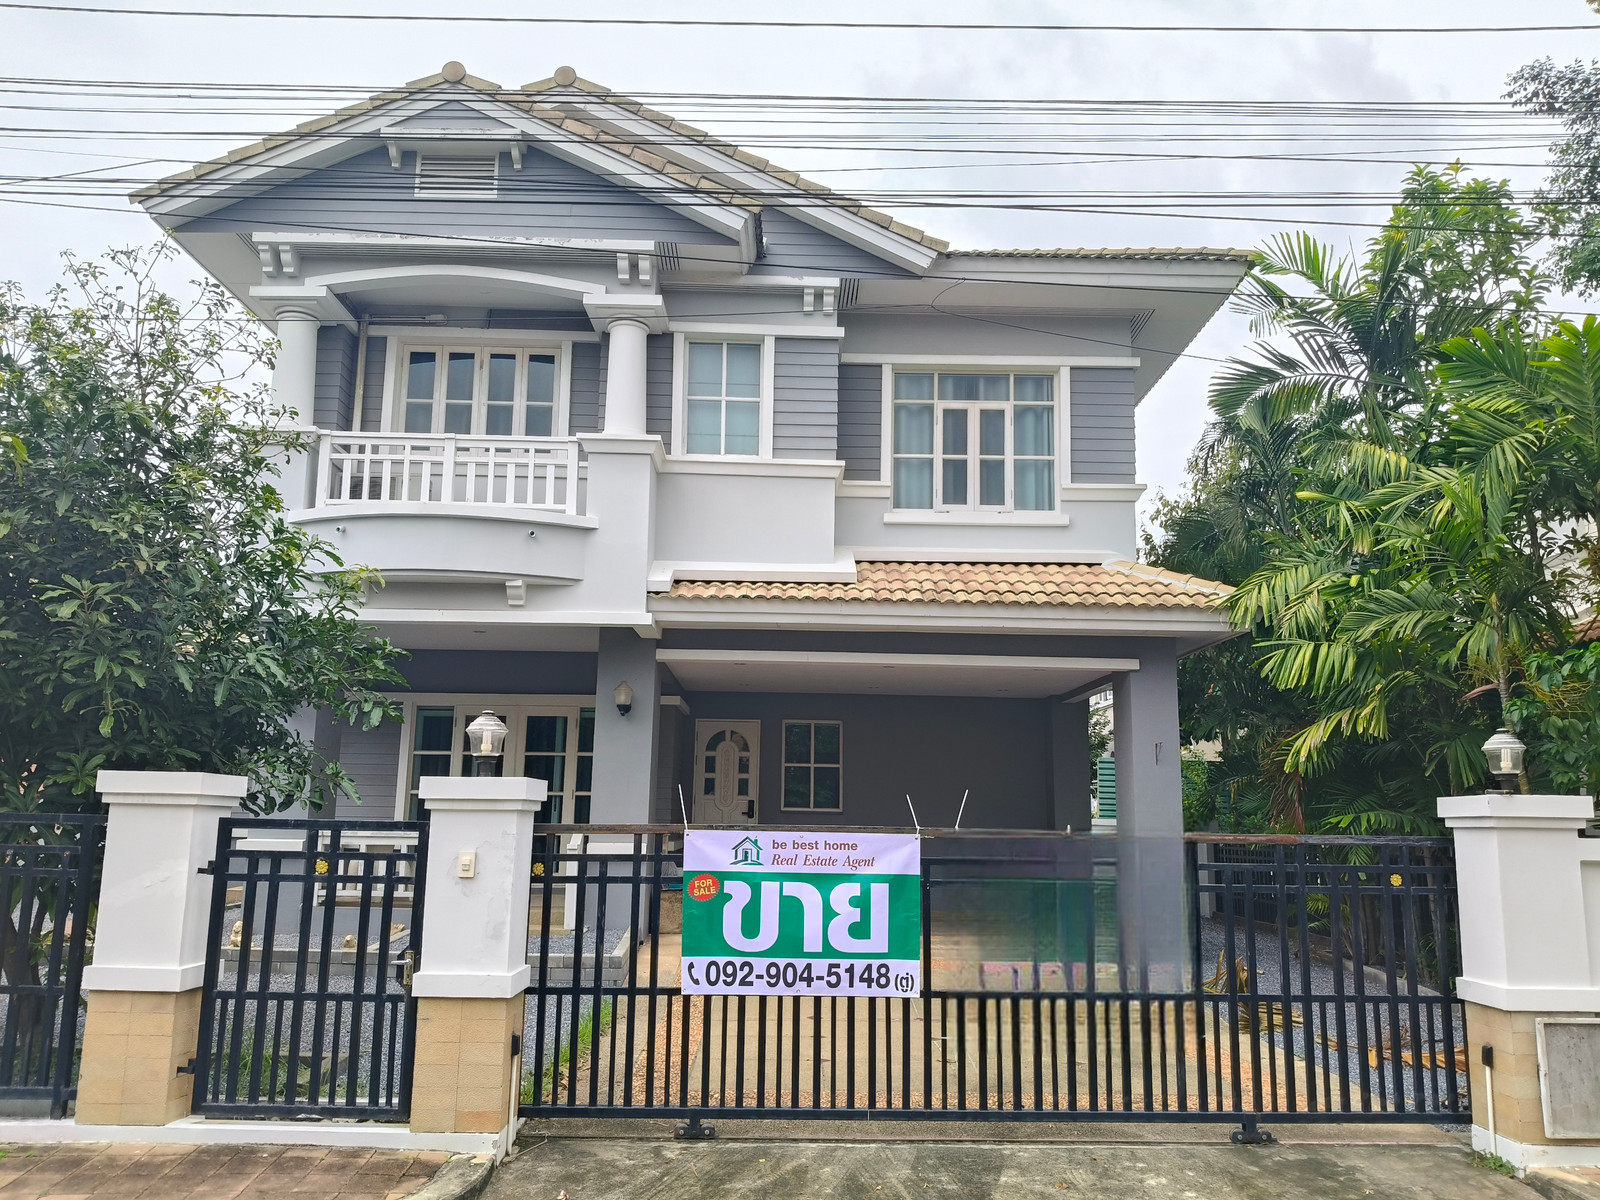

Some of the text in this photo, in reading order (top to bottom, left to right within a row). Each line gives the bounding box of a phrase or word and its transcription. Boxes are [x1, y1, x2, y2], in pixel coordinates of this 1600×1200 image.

[772, 839, 858, 851] be best home
[771, 853, 876, 871] Real Estate Agent
[694, 879, 713, 888] FOR
[693, 886, 717, 897] SALE
[722, 880, 890, 953] ขาย
[705, 960, 891, 989] 092-904-5148
